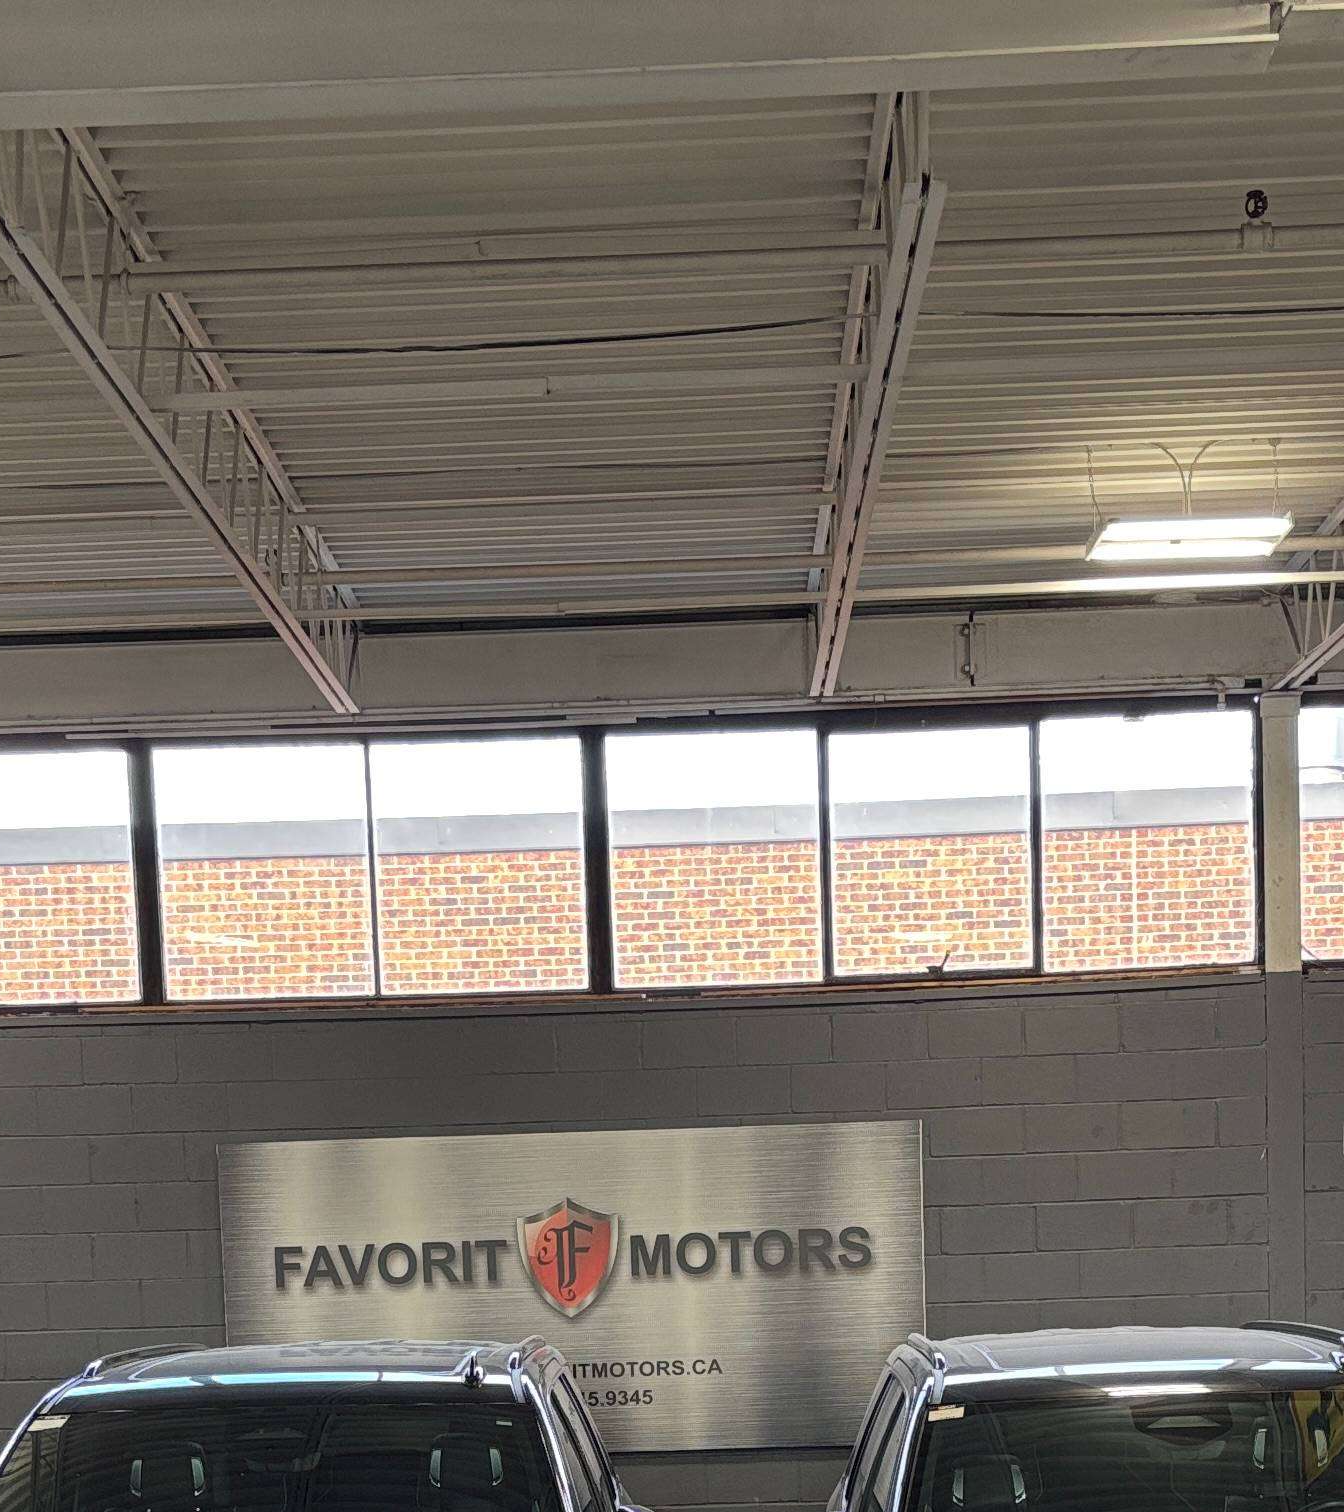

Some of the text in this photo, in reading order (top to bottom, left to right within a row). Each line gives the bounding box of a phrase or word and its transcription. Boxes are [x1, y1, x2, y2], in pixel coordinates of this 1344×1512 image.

[274, 1239, 507, 1288] FAVORIT
[629, 1226, 872, 1278] MOTORS
[572, 1359, 723, 1378] ITMOTORS.CA
[582, 1389, 654, 1407] 5.9345
